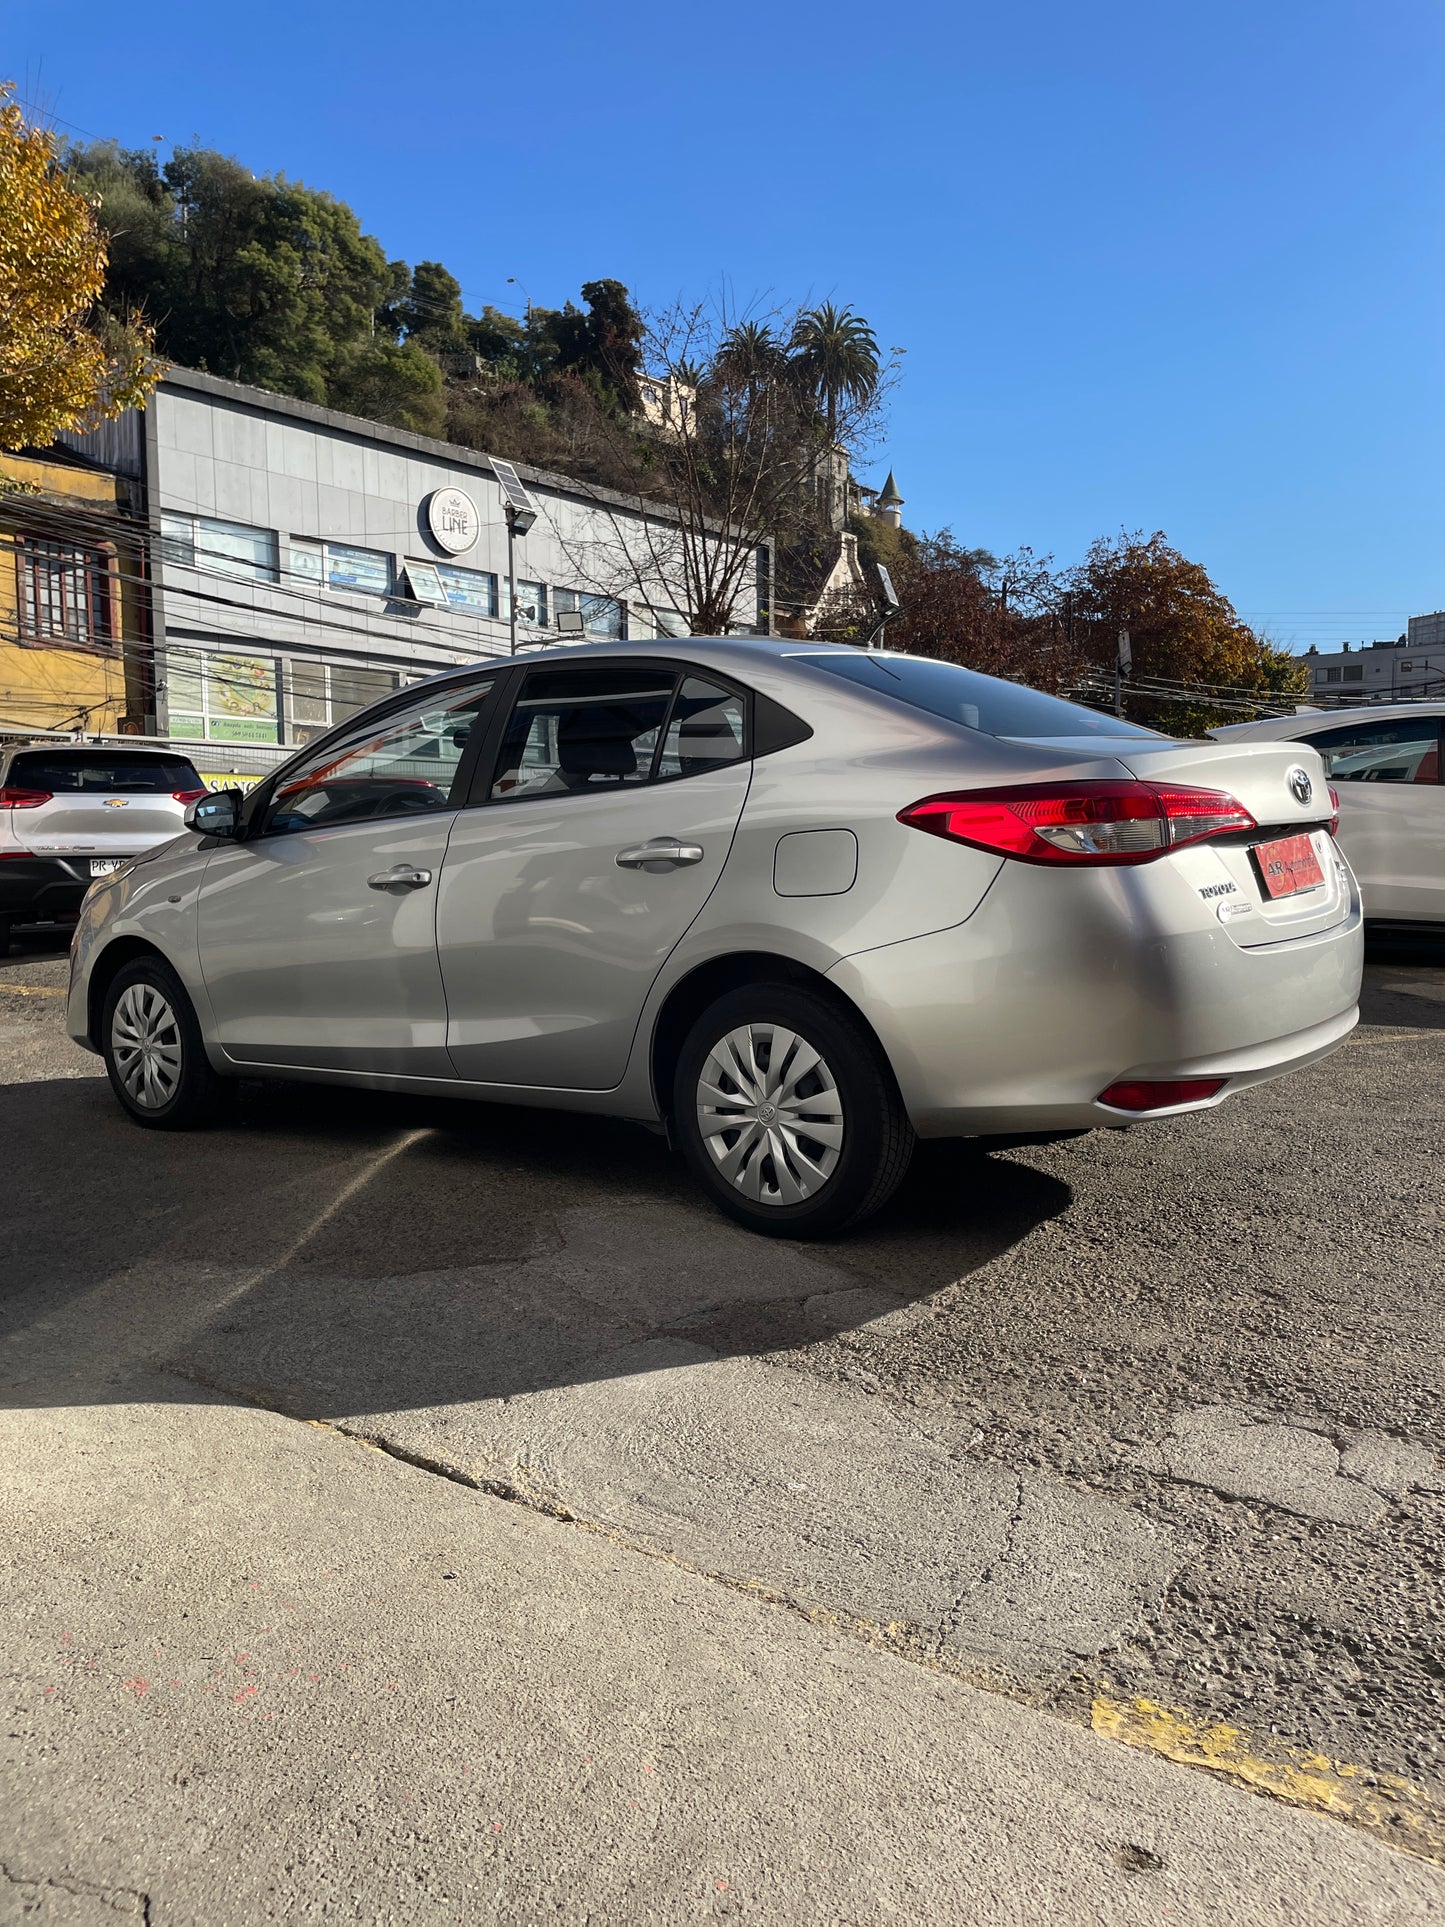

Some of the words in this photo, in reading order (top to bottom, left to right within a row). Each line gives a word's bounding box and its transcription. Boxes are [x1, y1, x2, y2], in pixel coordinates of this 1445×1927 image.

[442, 507, 467, 519] BARBER
[442, 516, 468, 535] LINE
[1198, 882, 1237, 900] TOYOTA
